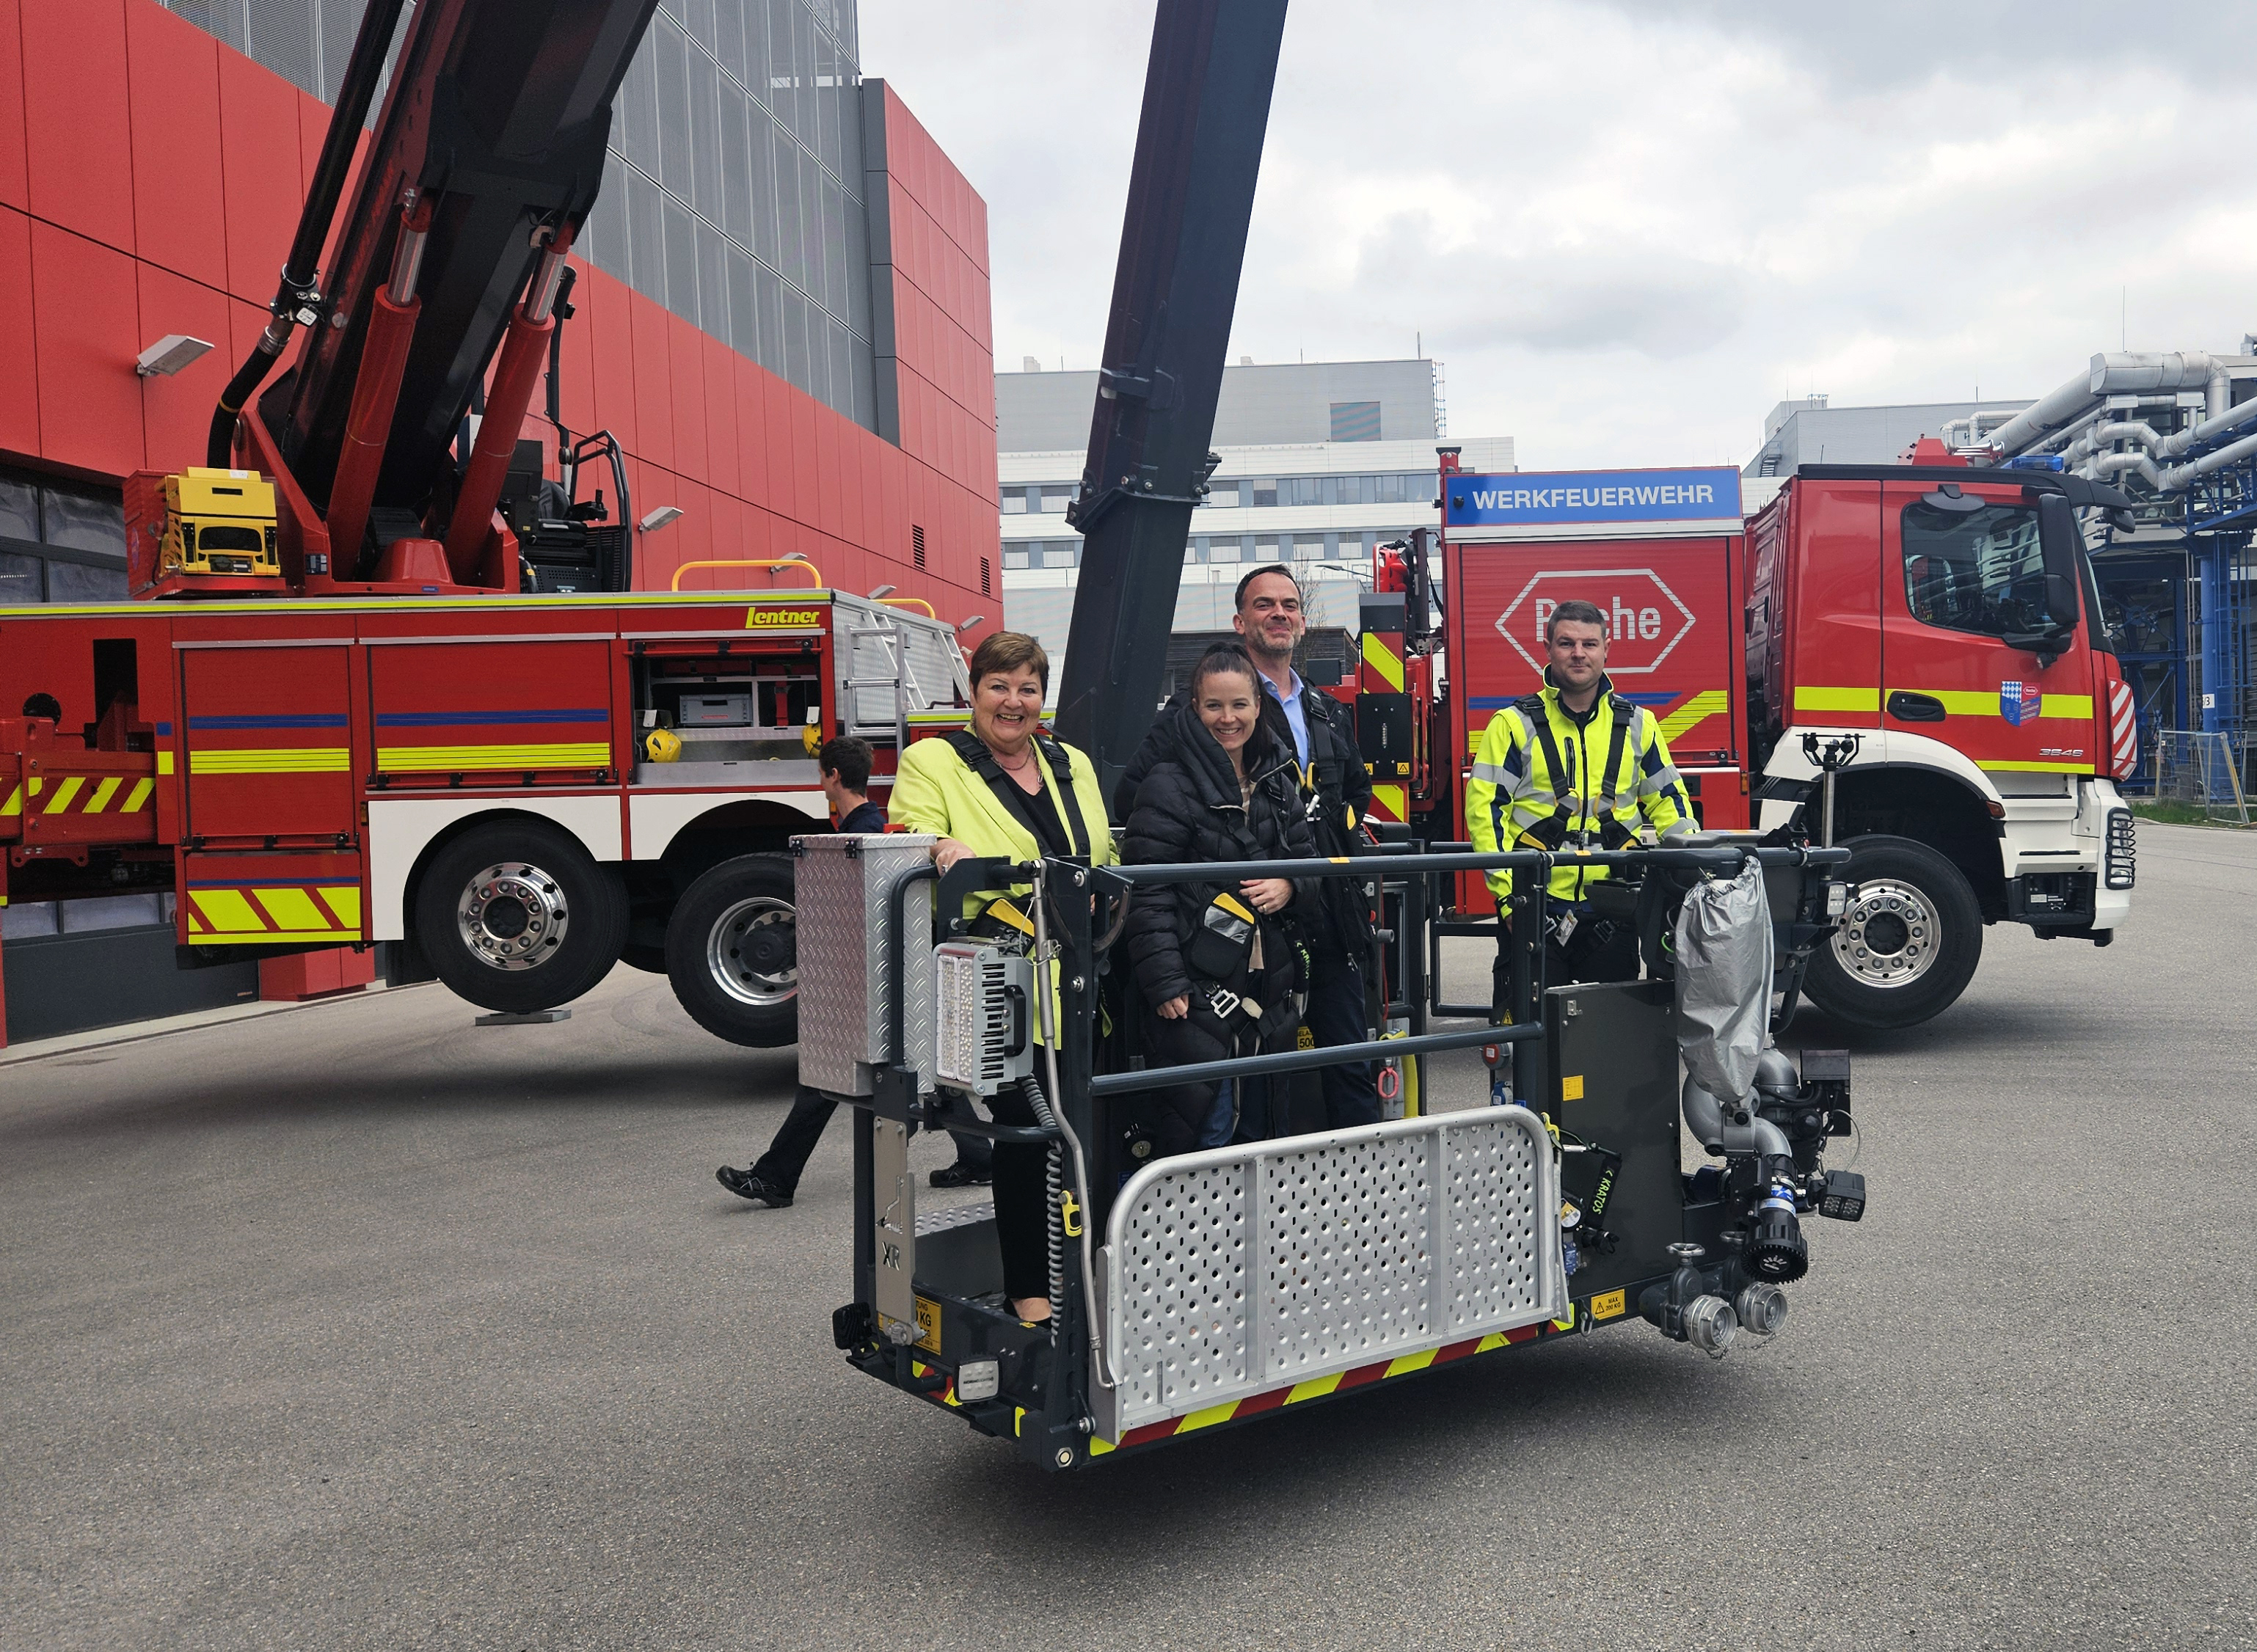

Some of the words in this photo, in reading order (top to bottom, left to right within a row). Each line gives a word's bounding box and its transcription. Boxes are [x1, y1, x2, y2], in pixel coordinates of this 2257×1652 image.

[1473, 484, 1714, 509] WERKFEUERWEHR
[745, 607, 820, 629] Lentner
[1536, 596, 1661, 642] Rhe
[1592, 1177, 1611, 1215] KRATOS
[882, 1241, 900, 1271] XR
[920, 1310, 932, 1327] KG
